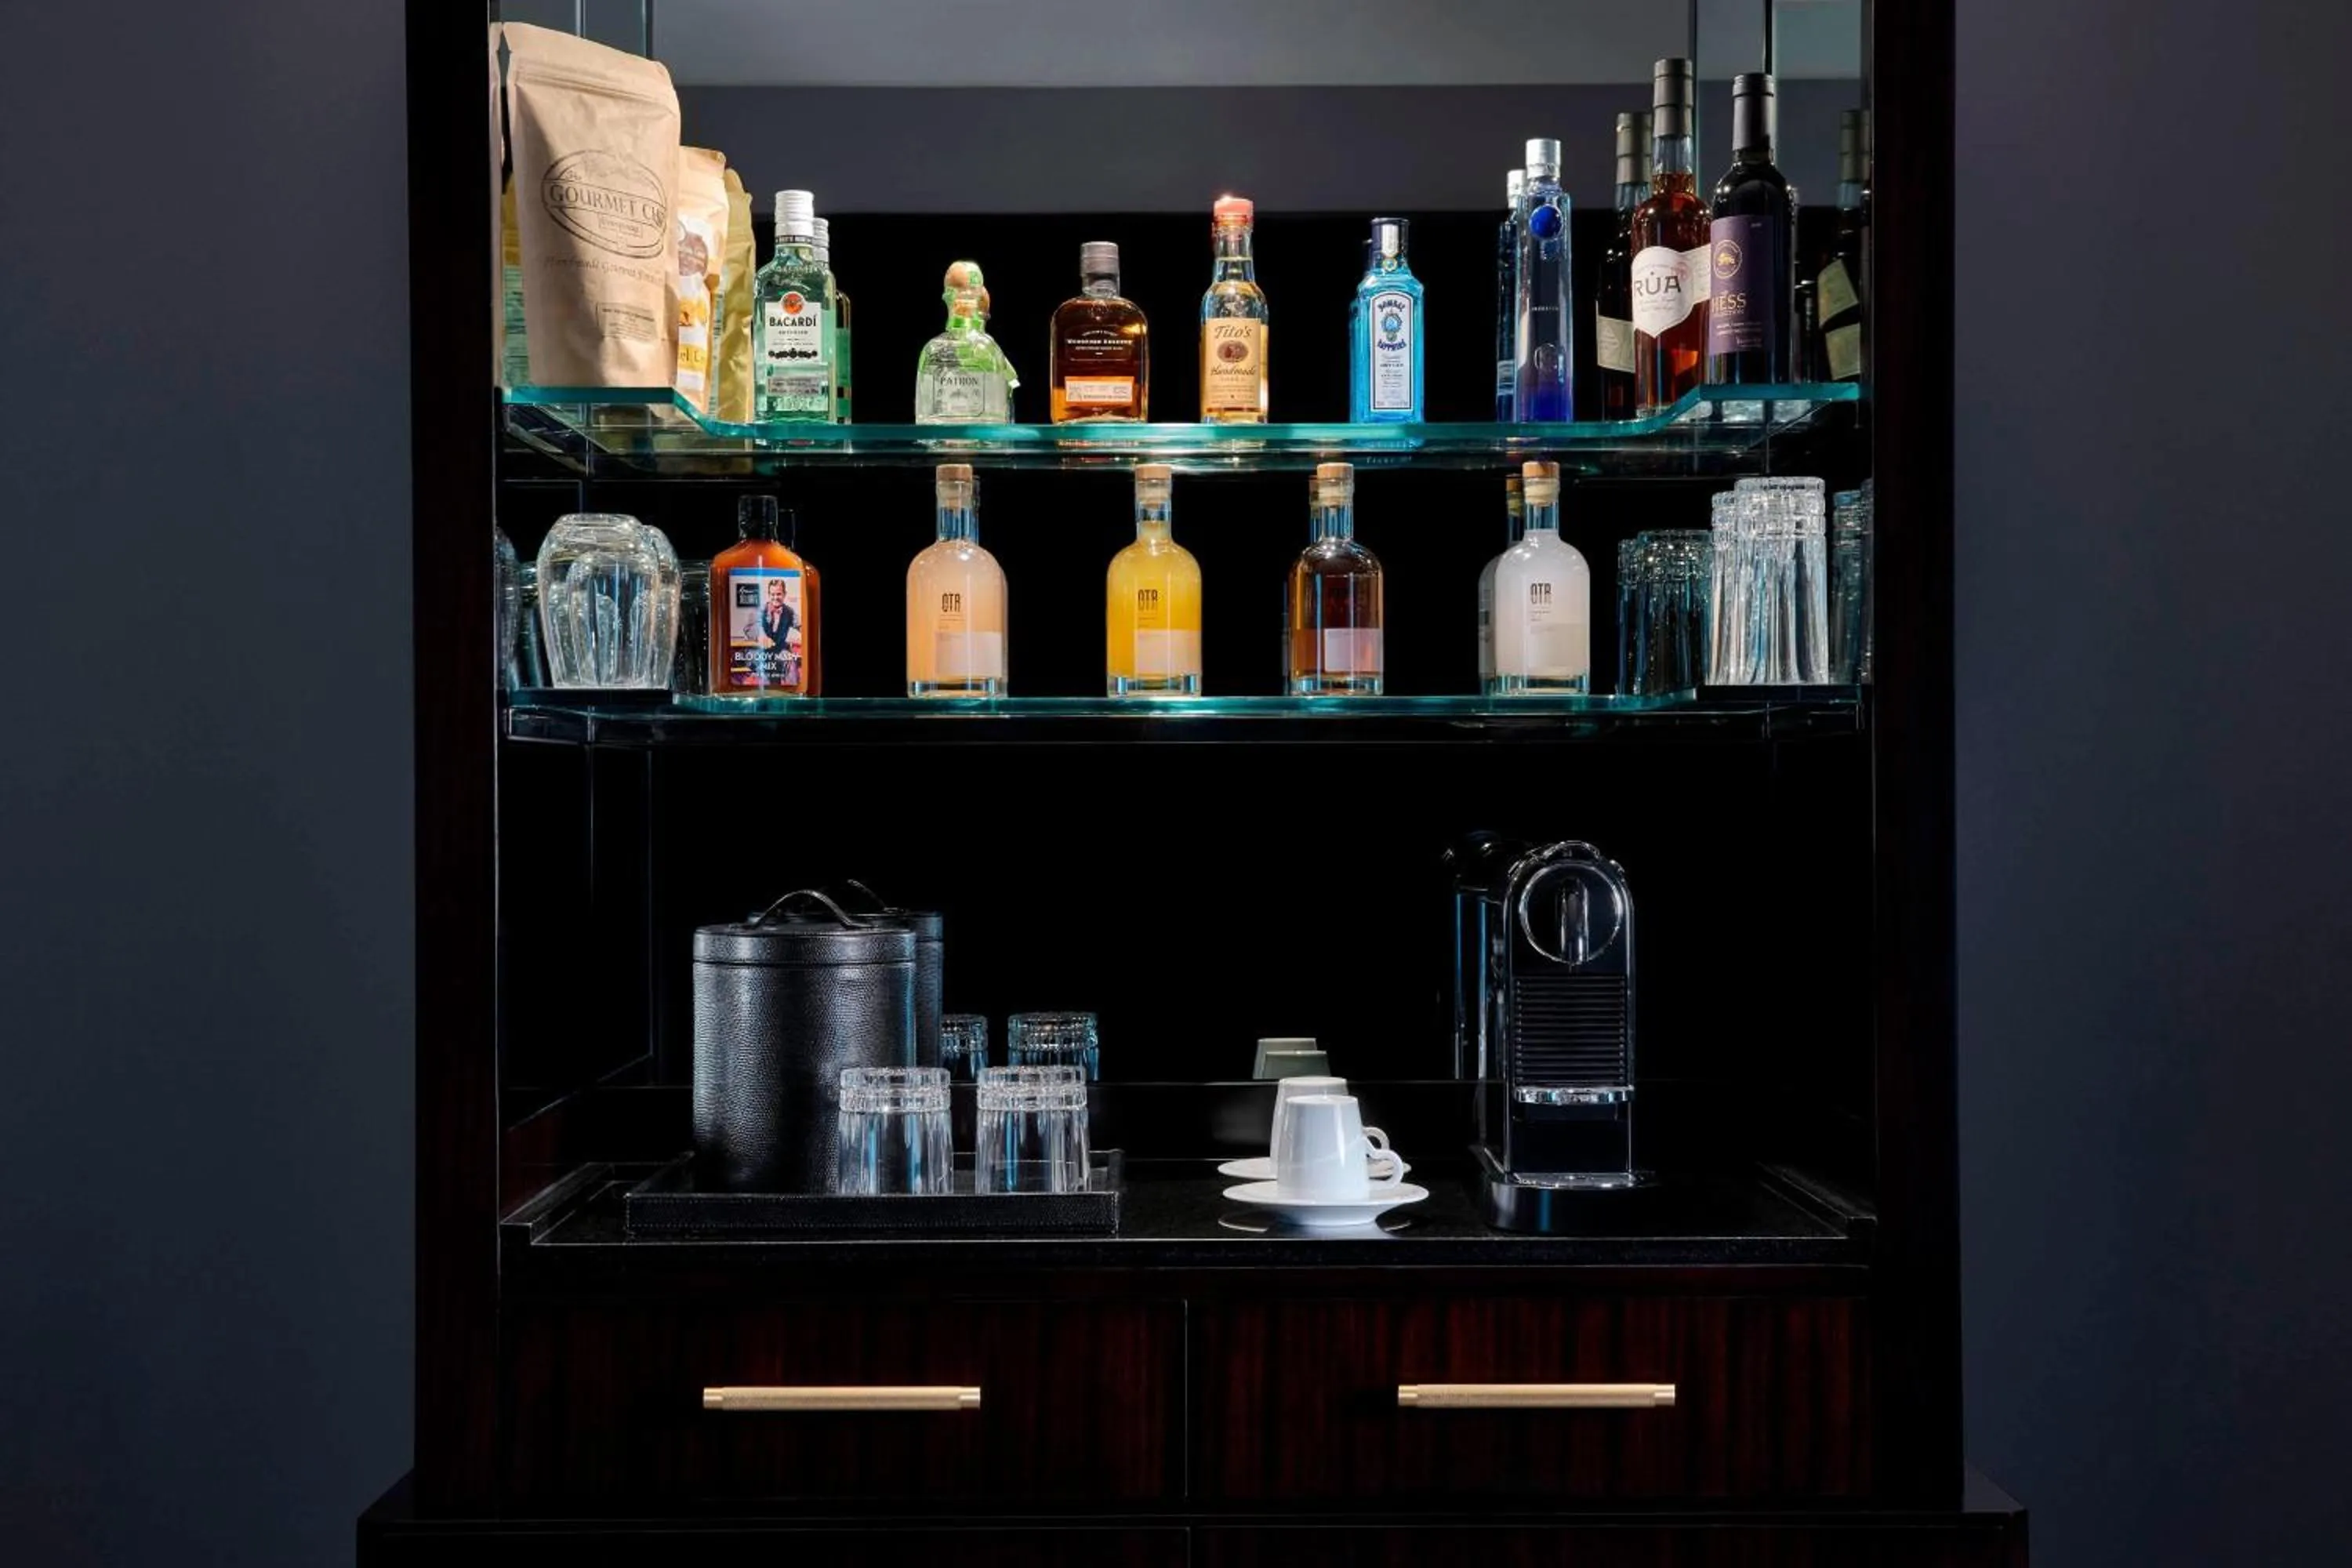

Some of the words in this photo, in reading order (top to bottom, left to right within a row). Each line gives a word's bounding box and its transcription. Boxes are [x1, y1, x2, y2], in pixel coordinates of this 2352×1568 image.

[550, 184, 637, 218] GOURMET
[1711, 292, 1747, 314] HESS
[1214, 325, 1252, 339] Tito's
[1138, 589, 1159, 612] OTR
[1530, 583, 1552, 604] OTR
